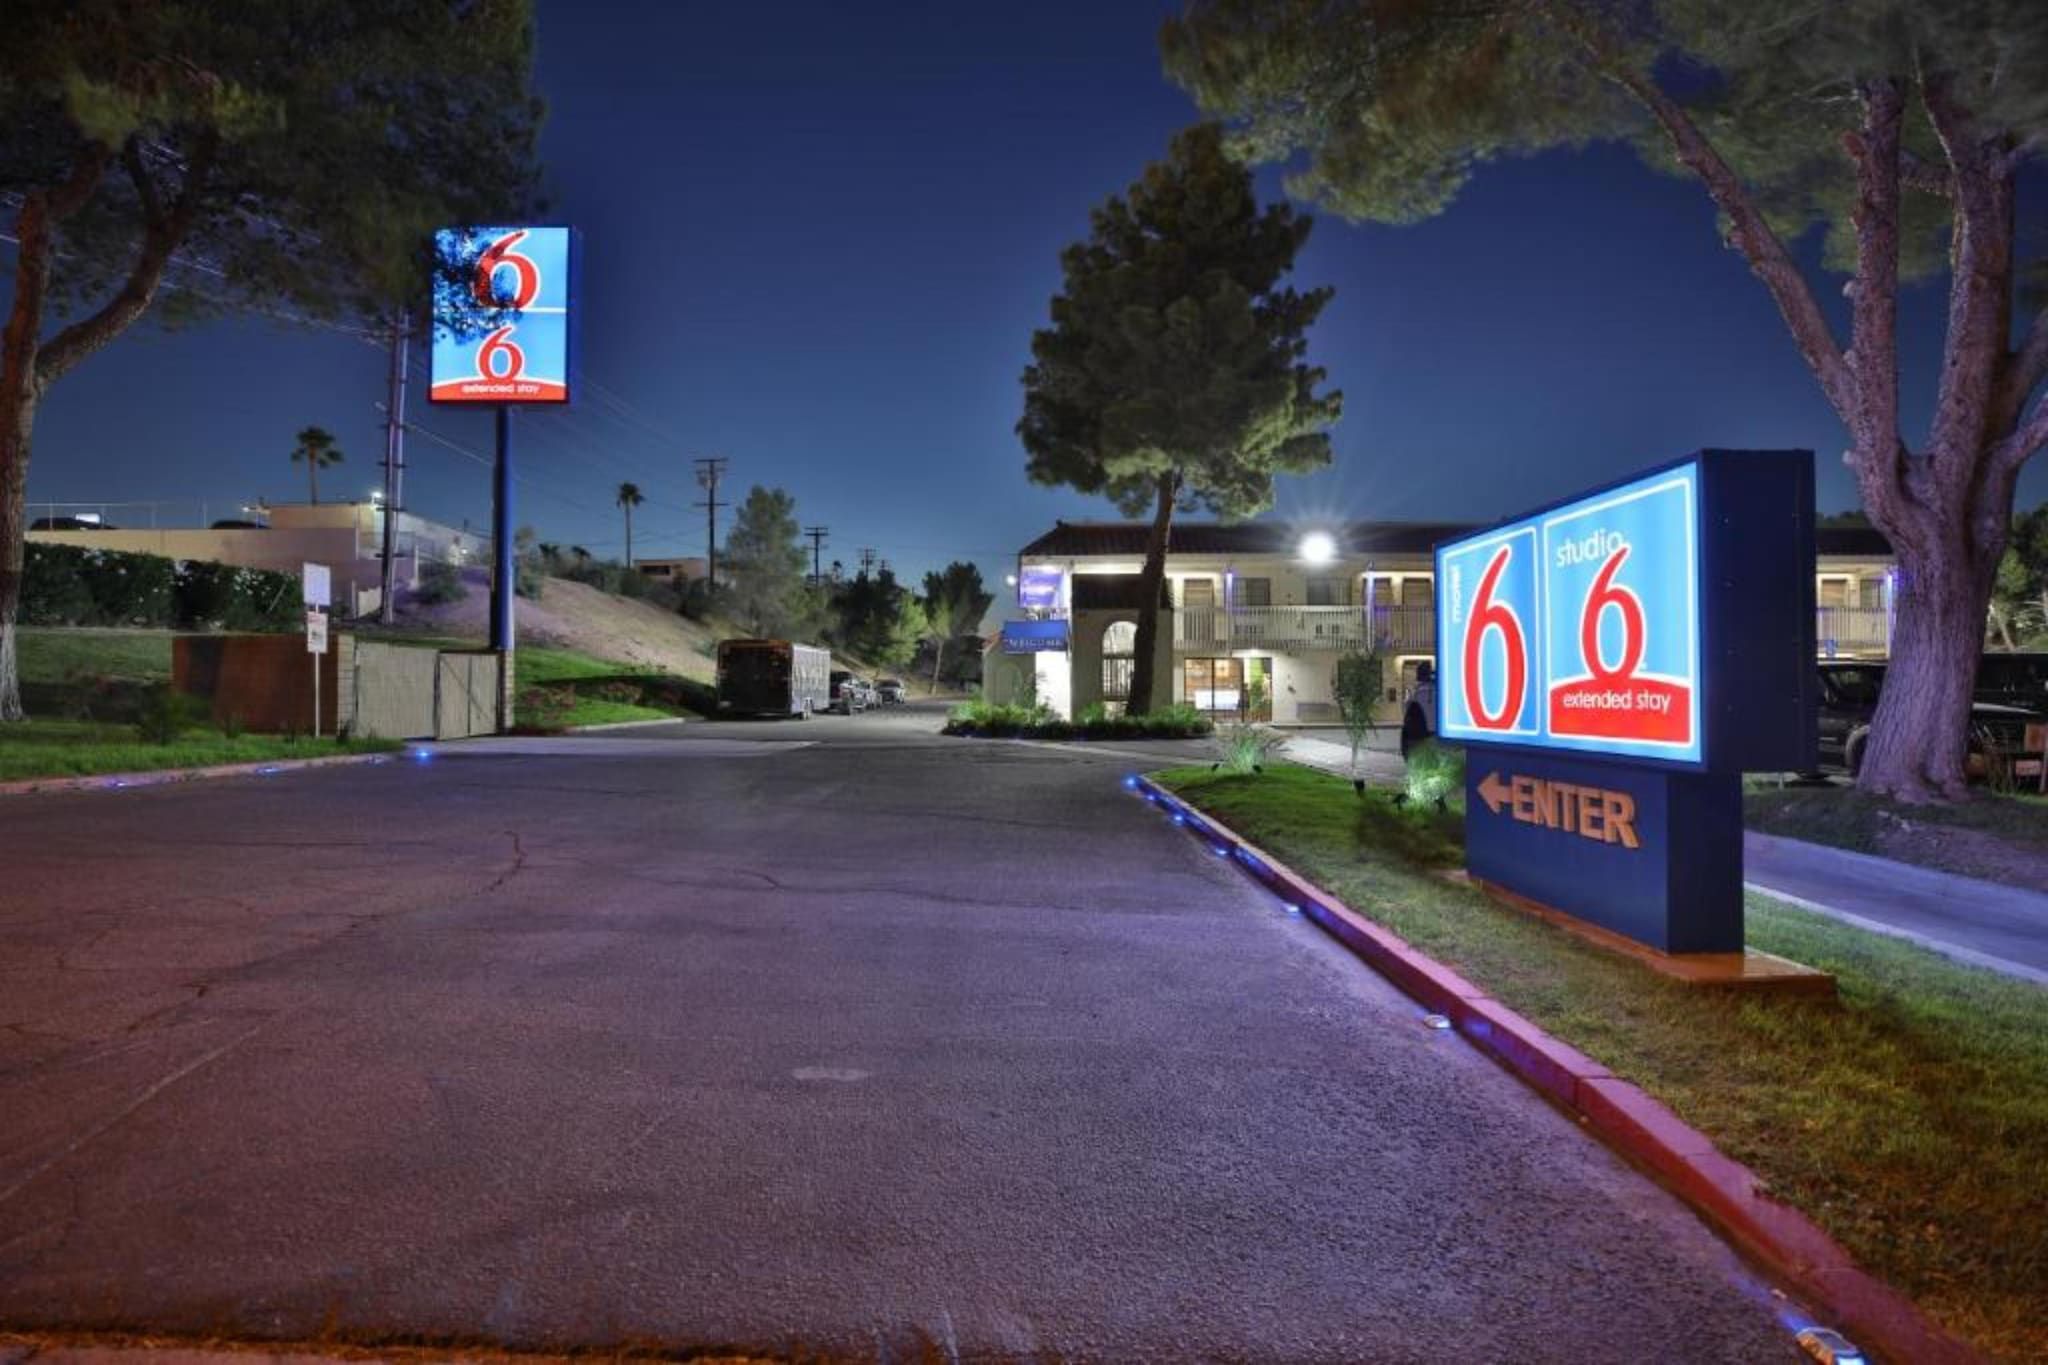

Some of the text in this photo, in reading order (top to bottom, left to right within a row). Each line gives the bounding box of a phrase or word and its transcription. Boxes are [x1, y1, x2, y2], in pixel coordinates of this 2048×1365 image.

[471, 230, 540, 309] 6
[477, 326, 524, 381] 6
[462, 384, 540, 395] extended stay
[1556, 529, 1624, 568] studio
[1461, 543, 1528, 730] 6
[1580, 543, 1647, 678] 6
[1563, 690, 1670, 716] extended stay
[1511, 774, 1639, 848] ENTER
